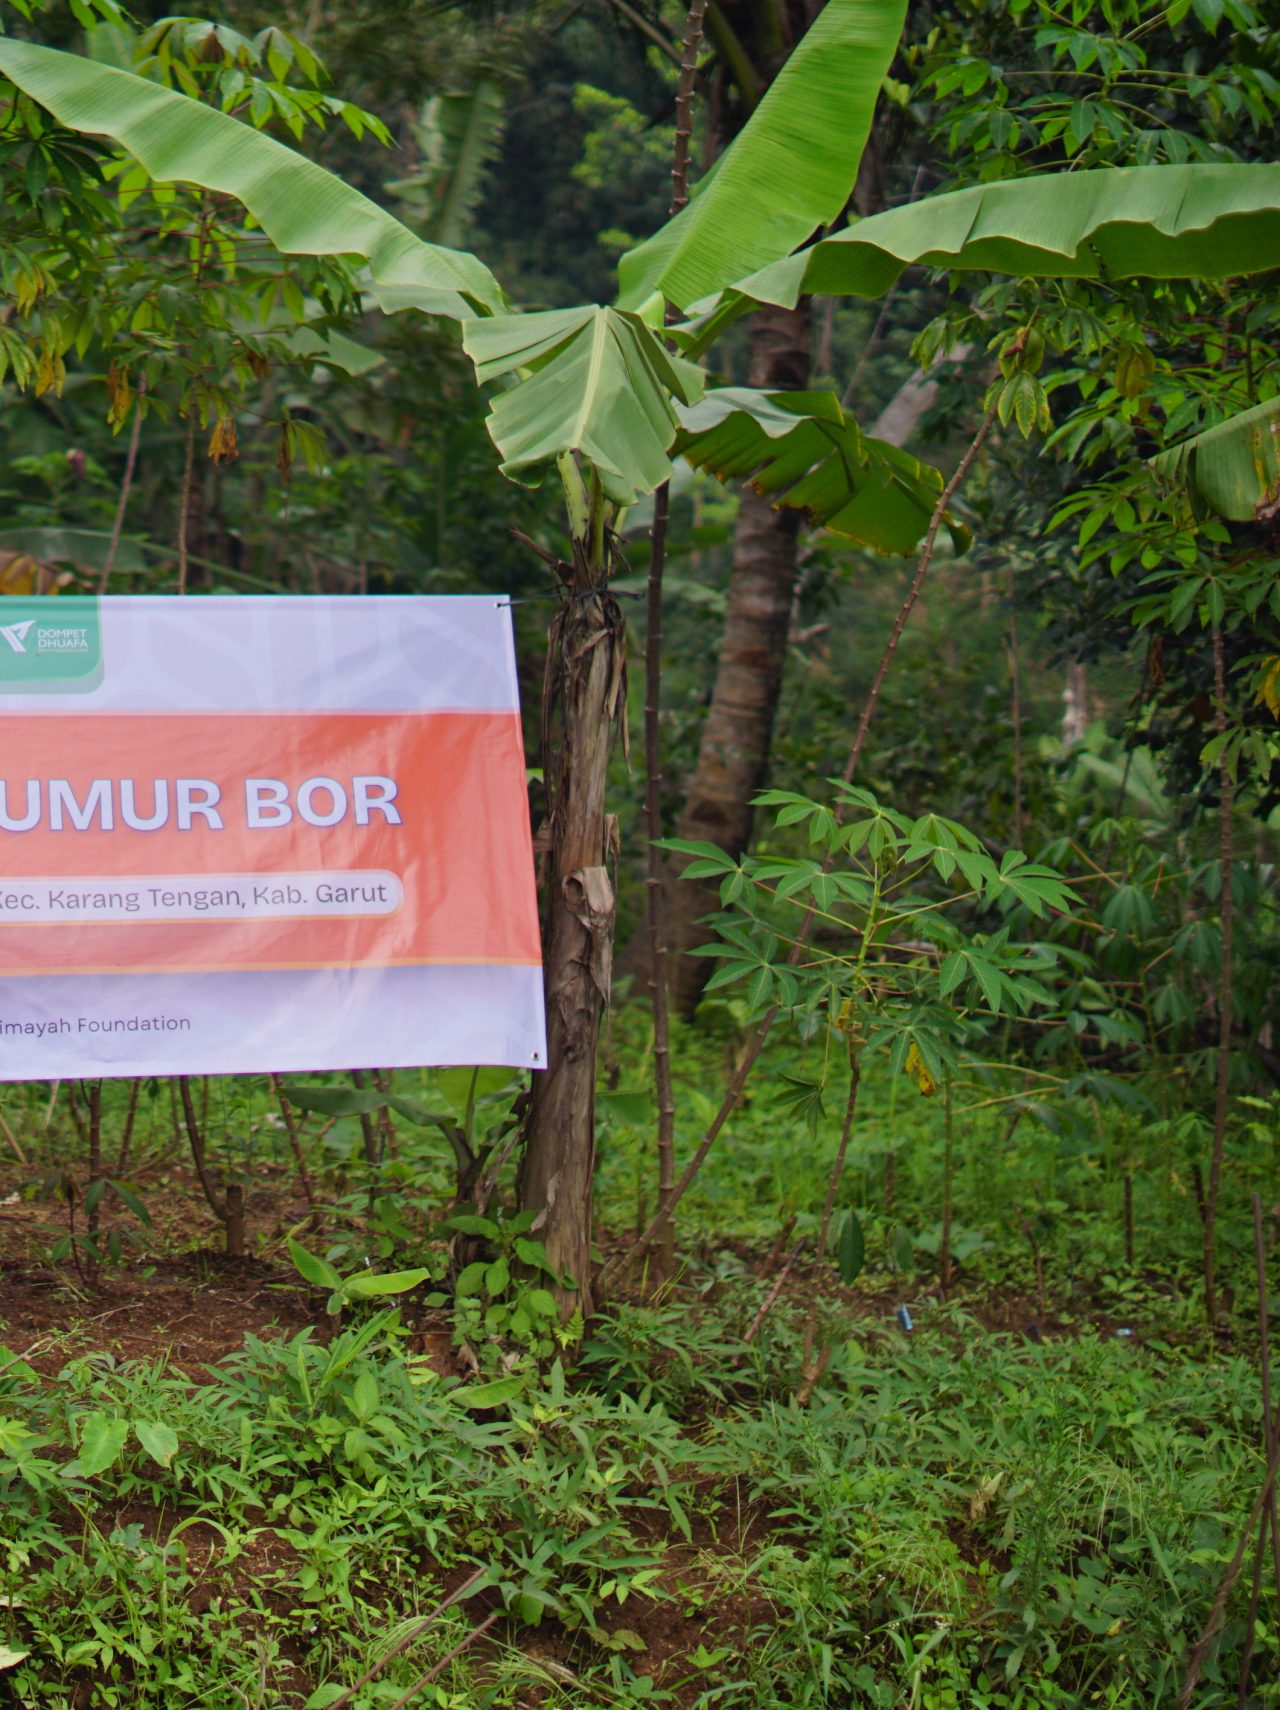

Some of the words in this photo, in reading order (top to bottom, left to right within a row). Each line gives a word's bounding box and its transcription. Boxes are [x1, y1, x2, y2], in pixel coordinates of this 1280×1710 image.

[37, 629, 88, 638] DOMPET
[38, 639, 88, 648] DHUAFA
[244, 775, 403, 829] BOR
[49, 889, 140, 912] Karang
[147, 887, 246, 910] Tengan,
[253, 886, 308, 906] Kab.
[315, 883, 387, 903] Garut
[79, 1016, 191, 1033] Foundation
